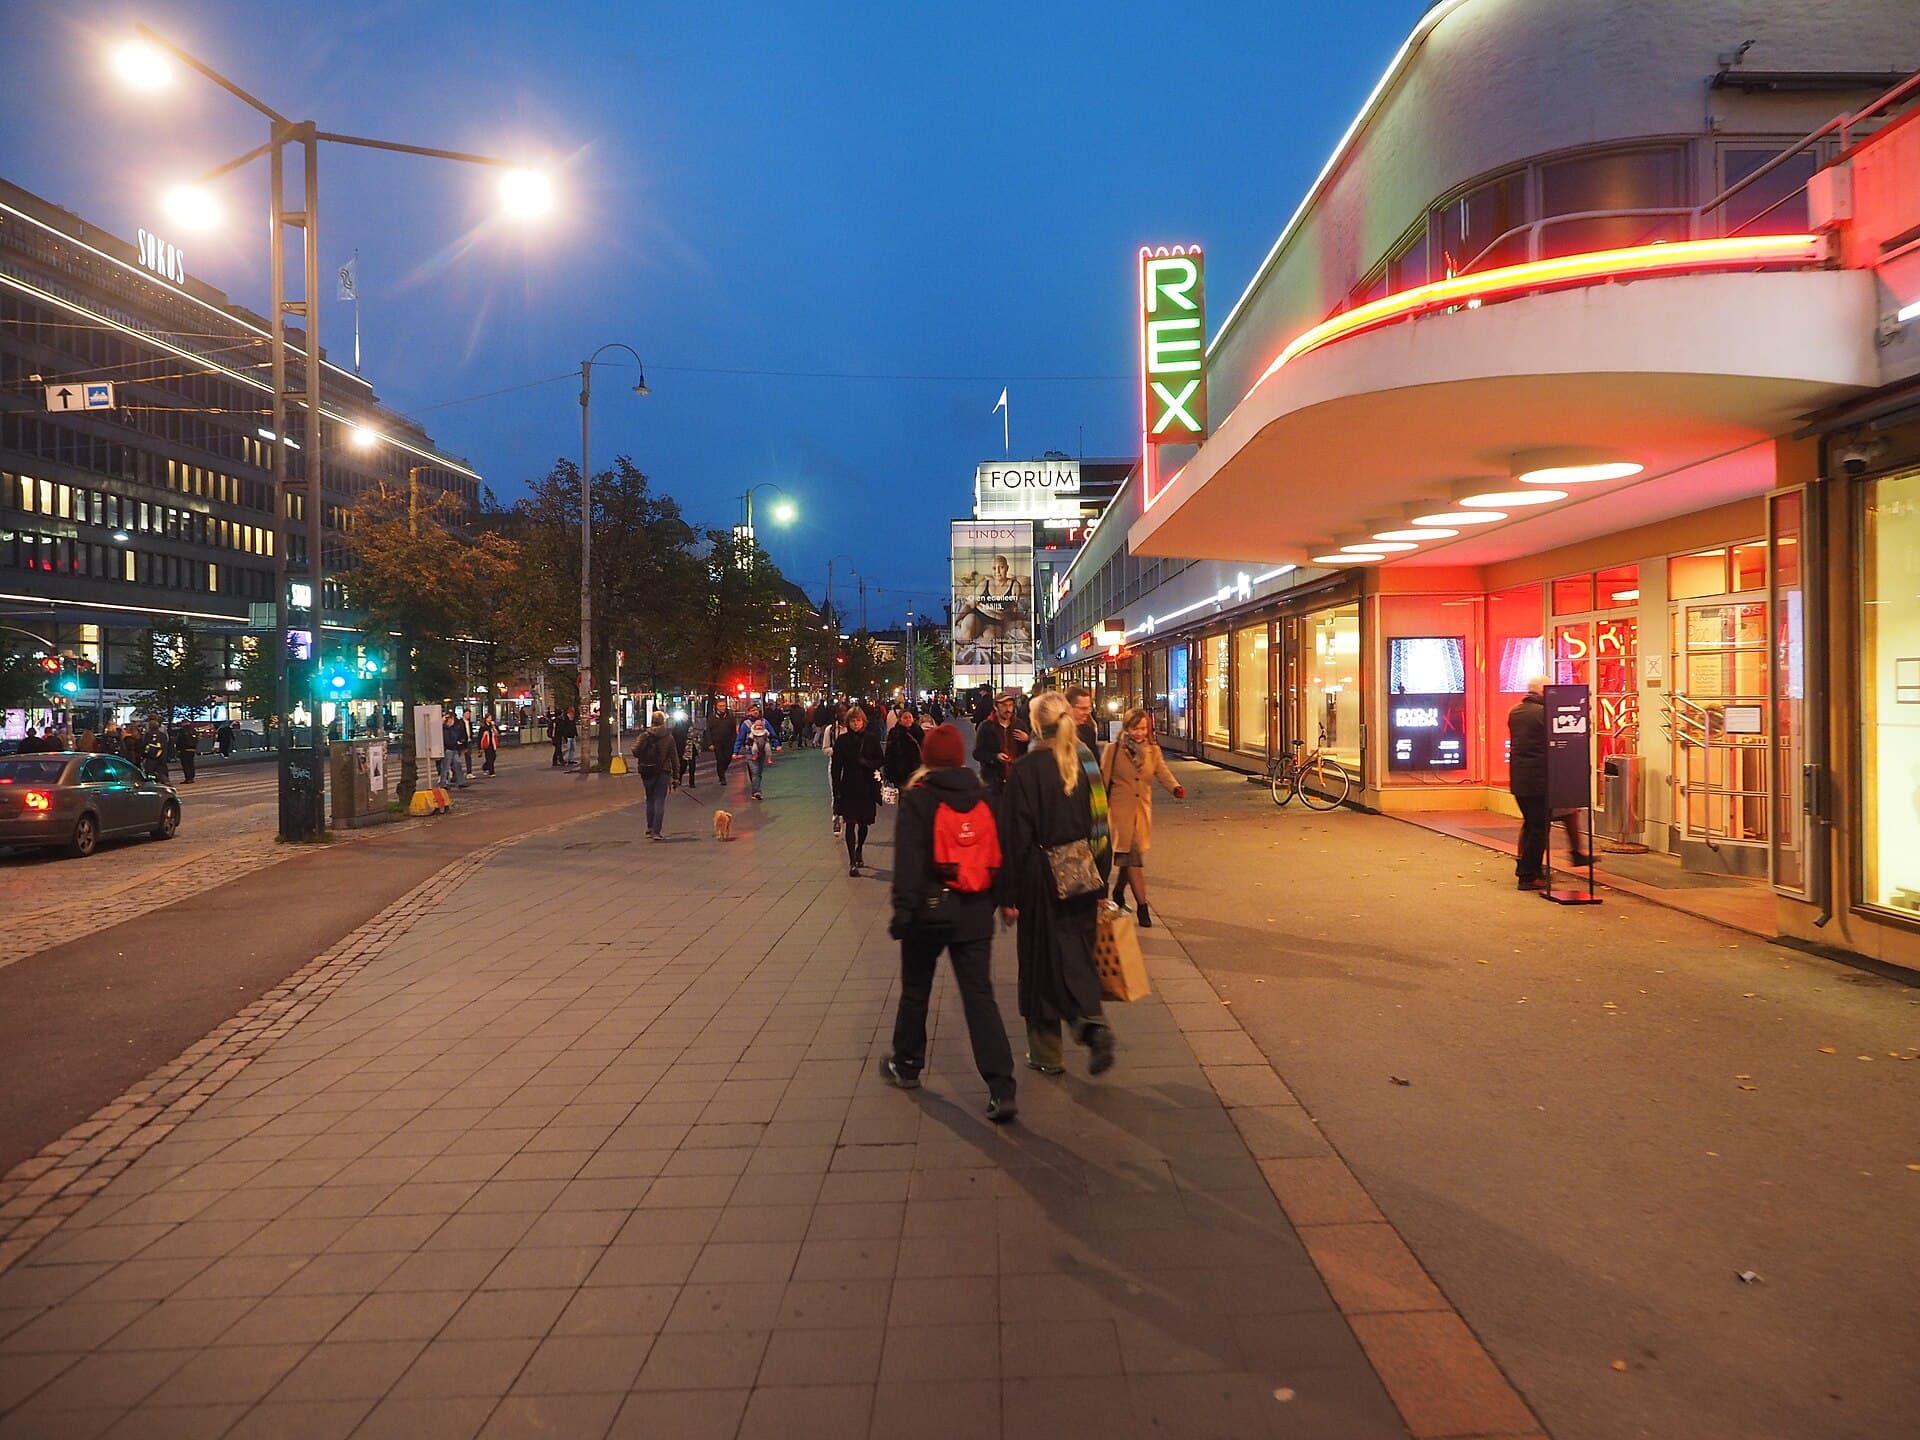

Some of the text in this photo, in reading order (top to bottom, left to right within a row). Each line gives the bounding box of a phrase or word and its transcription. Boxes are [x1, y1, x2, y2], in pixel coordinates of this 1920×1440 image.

[138, 228, 184, 285] SOKOS
[1147, 258, 1202, 434] REX
[992, 470, 1075, 488] FORUM
[968, 529, 1015, 539] LINDEX
